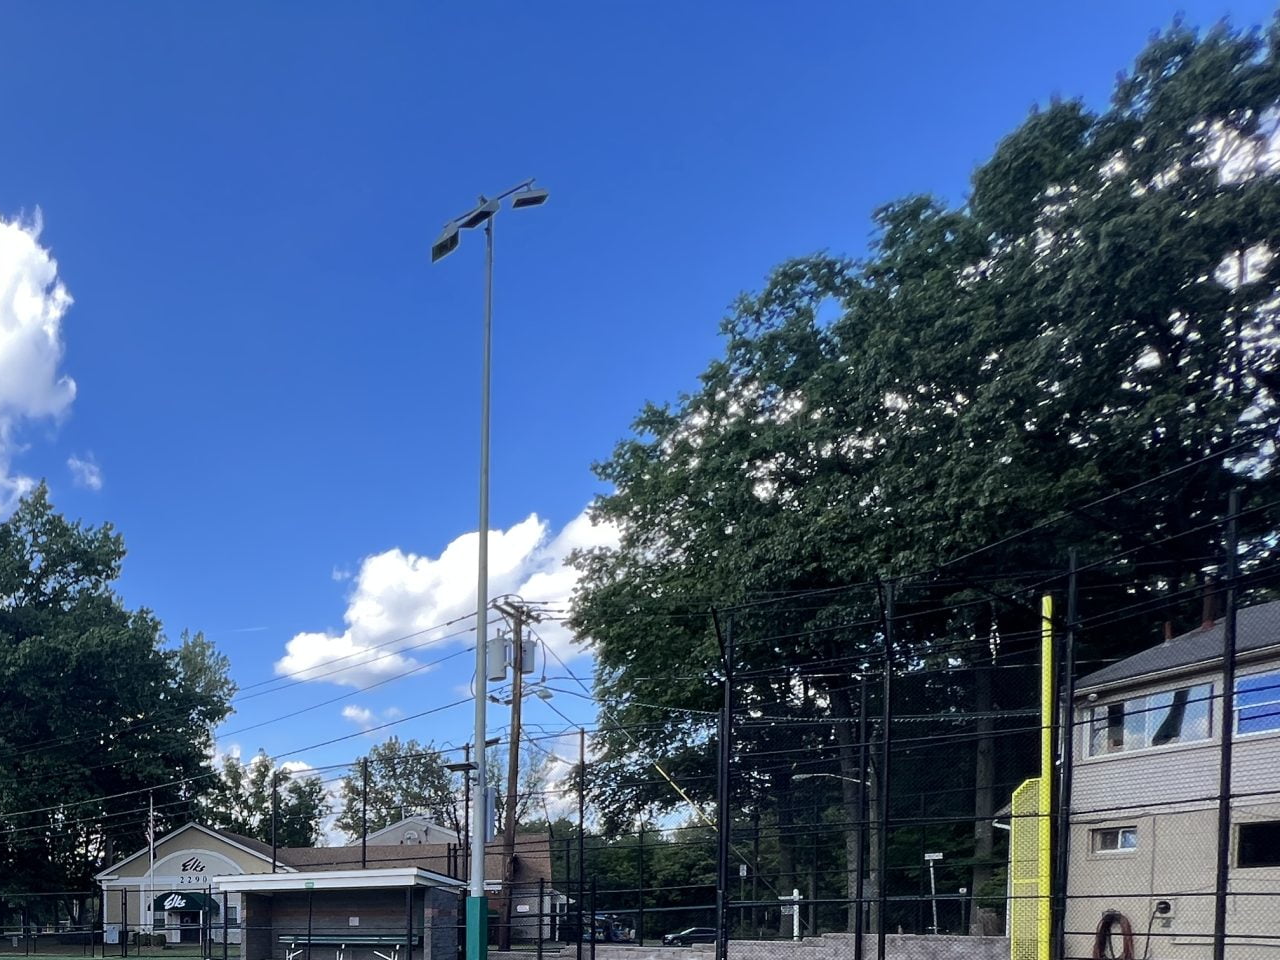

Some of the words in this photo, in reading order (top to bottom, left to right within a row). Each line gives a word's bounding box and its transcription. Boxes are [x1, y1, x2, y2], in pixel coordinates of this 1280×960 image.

[181, 856, 206, 873] Elks
[180, 876, 207, 884] 2290
[163, 893, 187, 910] Elks
